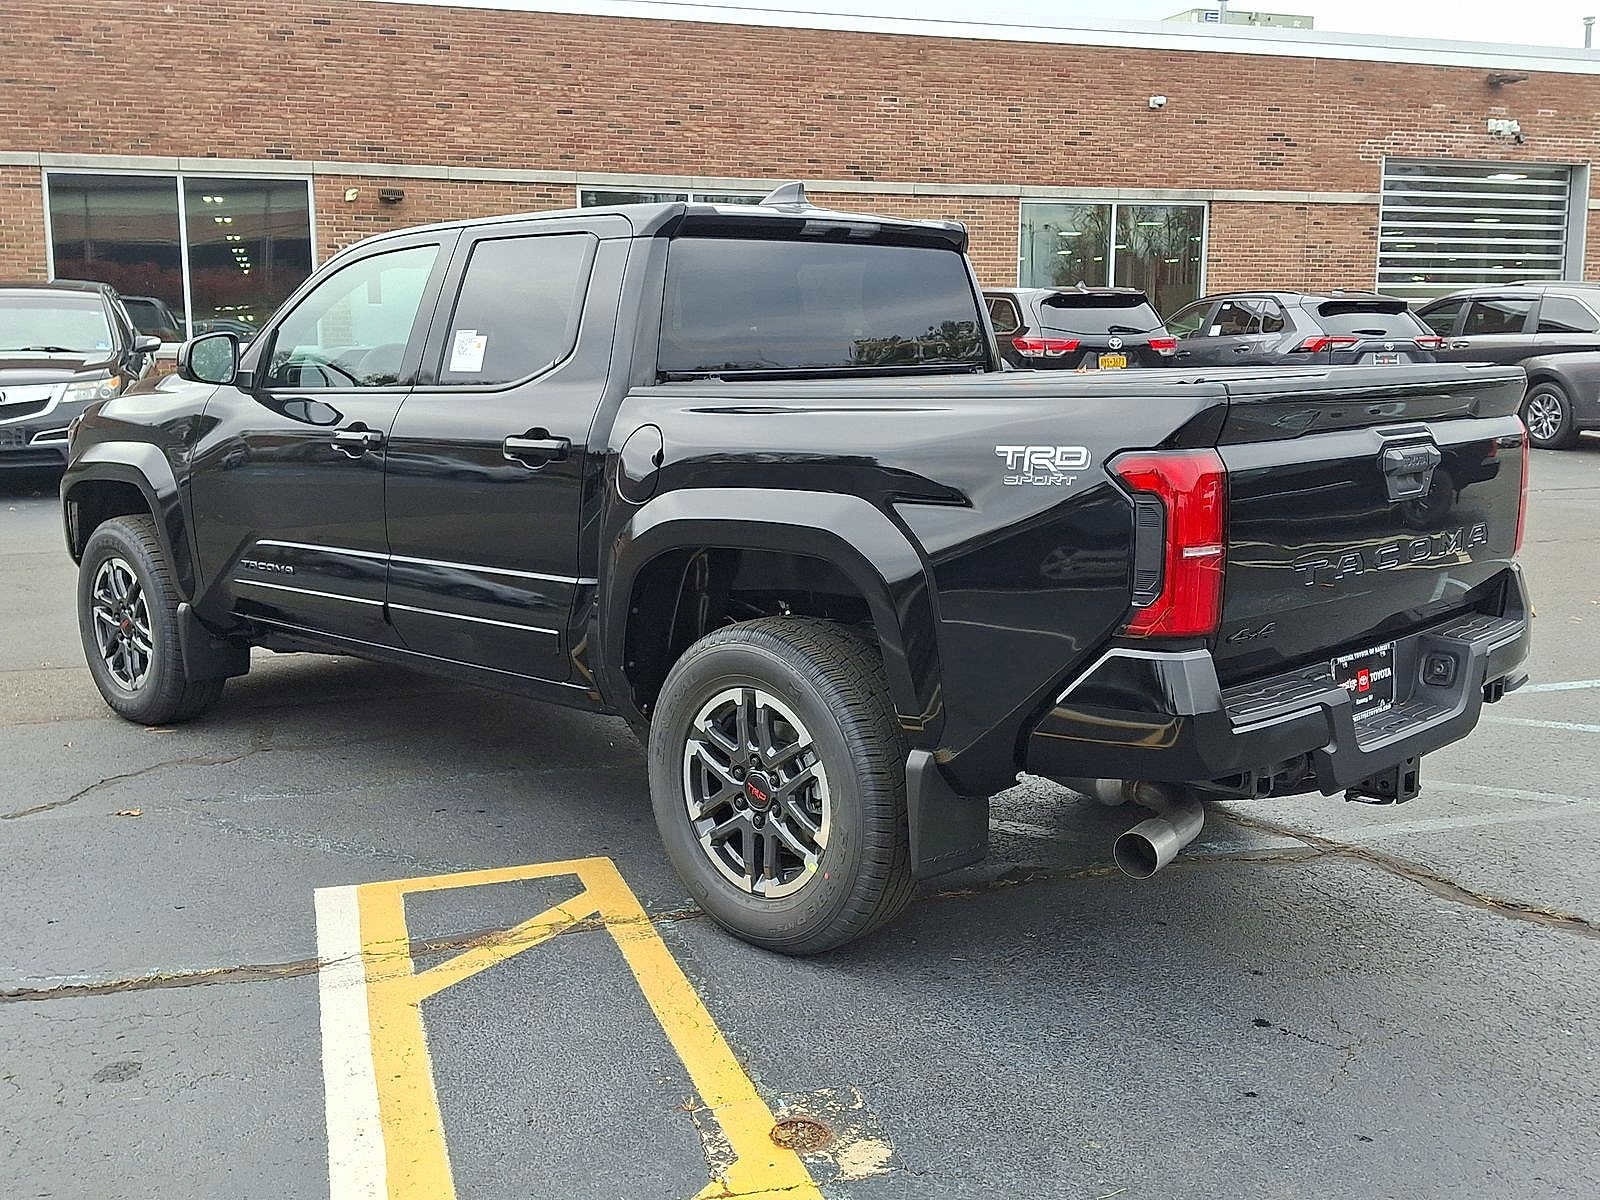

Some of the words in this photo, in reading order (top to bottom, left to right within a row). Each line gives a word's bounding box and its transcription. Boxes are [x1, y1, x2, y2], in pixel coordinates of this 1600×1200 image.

[995, 445, 1092, 477] TRD
[1003, 475, 1078, 487] SPORT
[1293, 521, 1488, 587] TACOMA
[240, 559, 296, 575] TACOMA
[1370, 667, 1392, 682] TOYOTA
[747, 782, 767, 801] TRD
